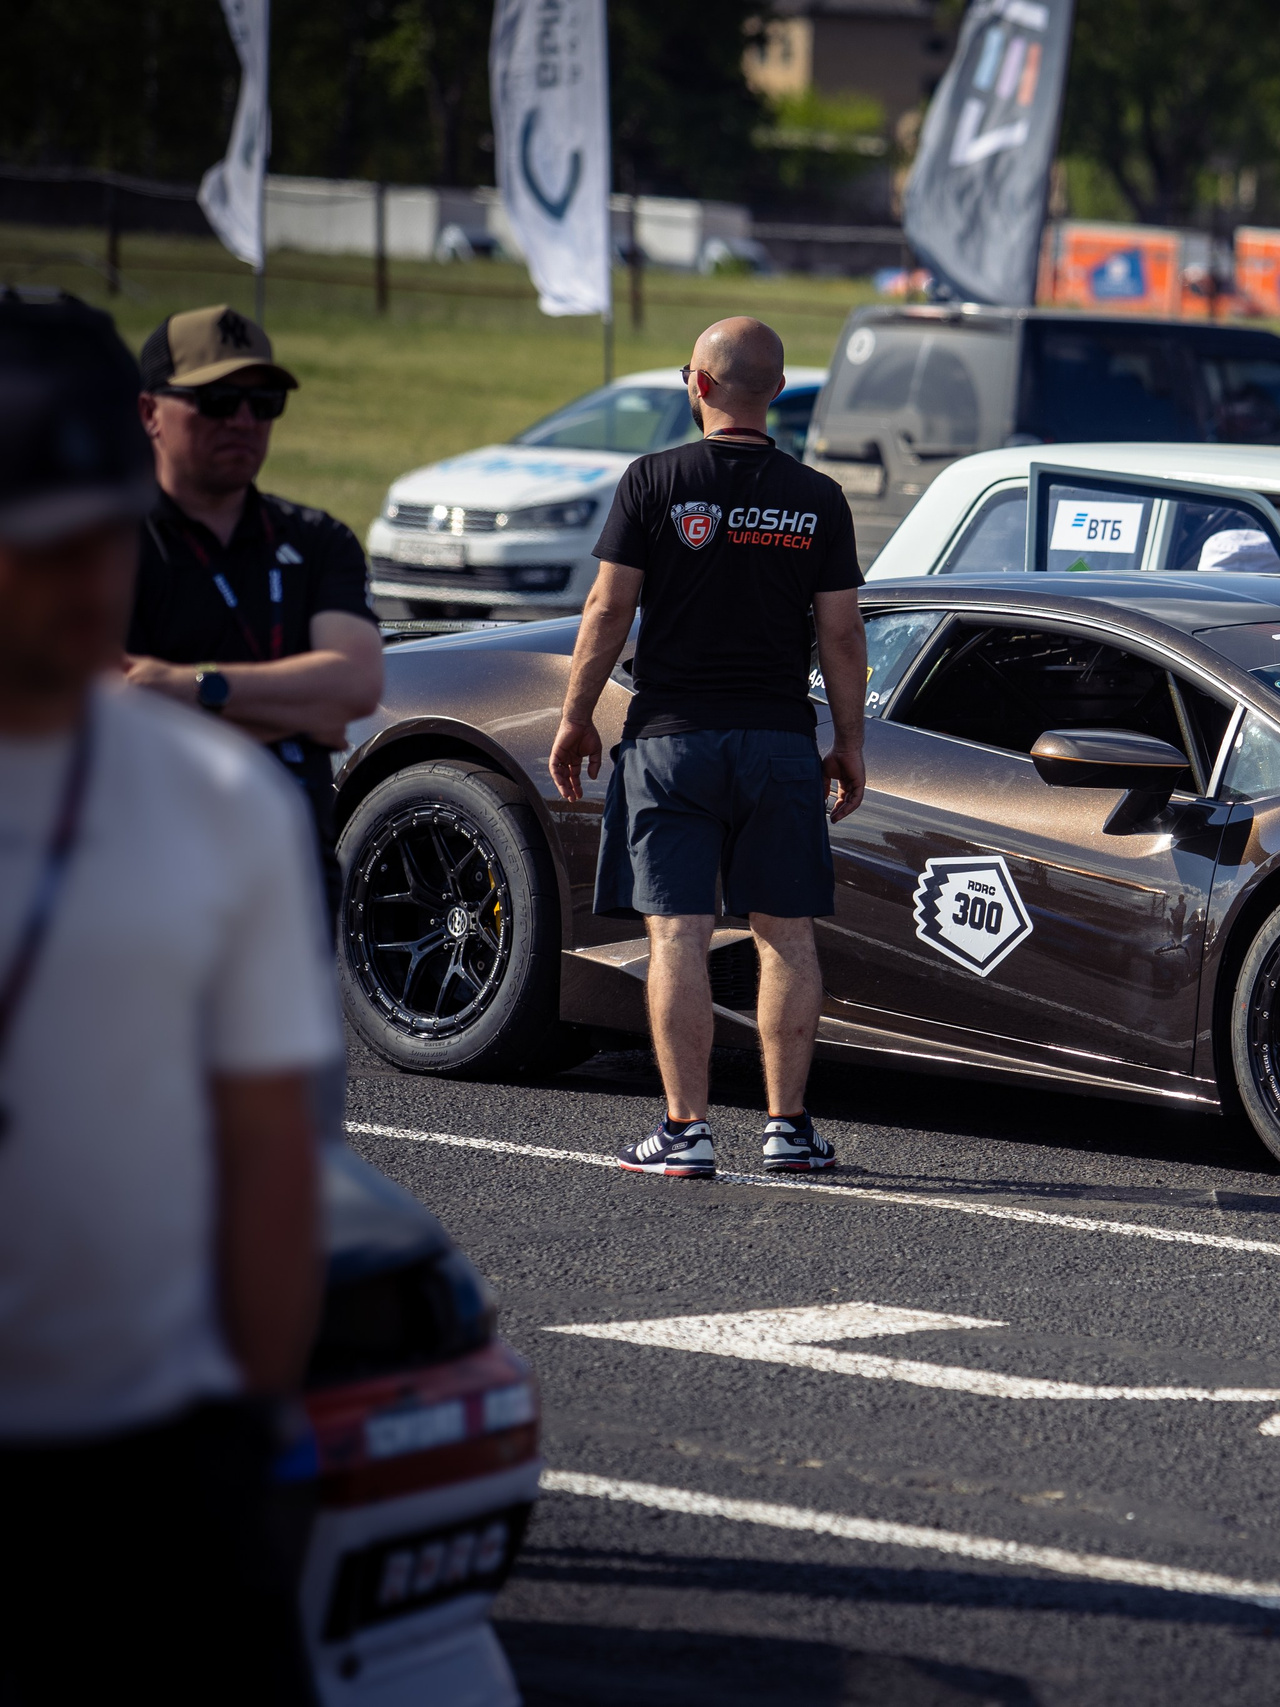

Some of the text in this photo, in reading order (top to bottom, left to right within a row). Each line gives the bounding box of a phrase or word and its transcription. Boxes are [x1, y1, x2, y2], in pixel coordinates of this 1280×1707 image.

[728, 507, 818, 535] GOSHA
[1086, 518, 1123, 541] ВТБ
[727, 531, 812, 550] TURBOTECH
[967, 880, 996, 896] RDRC
[952, 891, 1004, 936] 300
